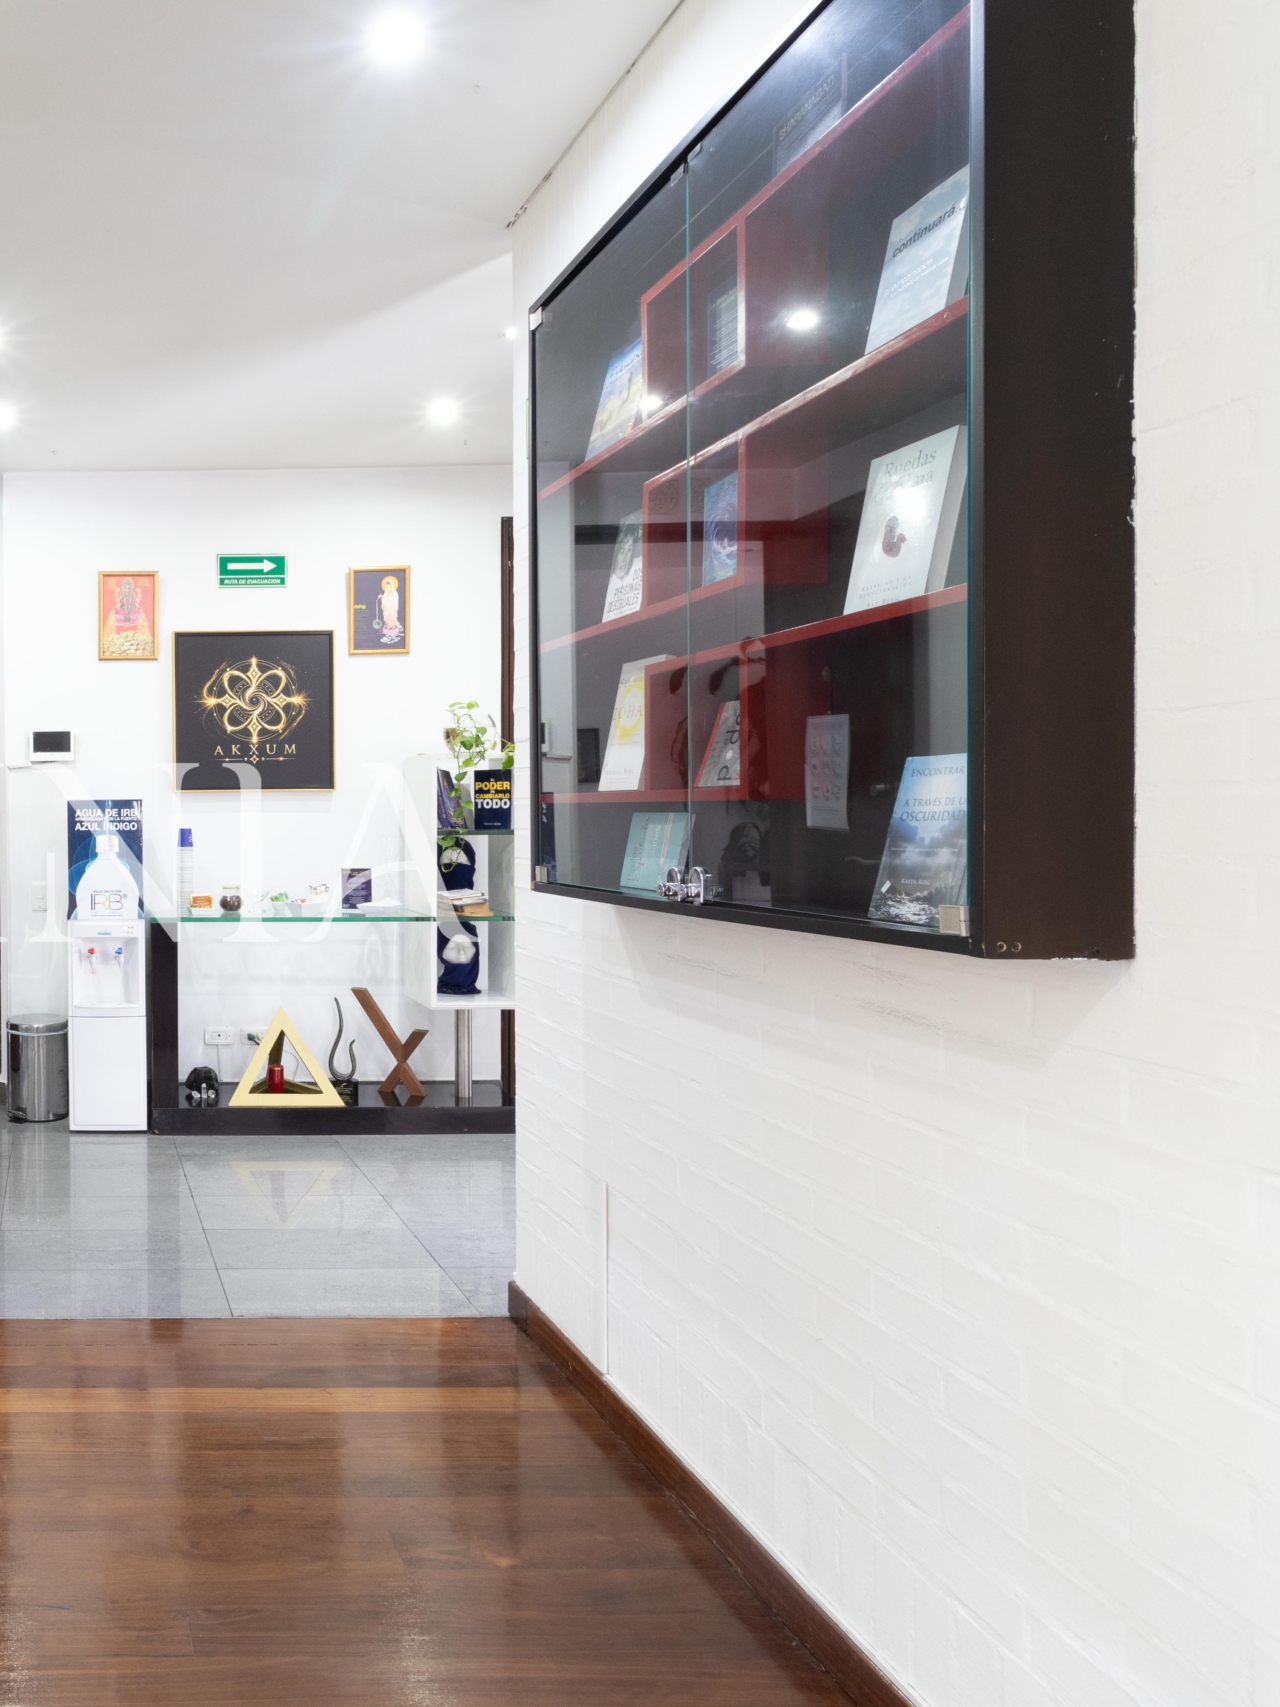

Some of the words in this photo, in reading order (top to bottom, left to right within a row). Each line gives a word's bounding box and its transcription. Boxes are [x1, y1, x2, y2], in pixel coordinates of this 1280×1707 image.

[885, 449, 937, 479] Ruedas
[612, 703, 642, 721] ZÓHA
[214, 743, 296, 755] AKXUM
[911, 765, 965, 778] ENCONTRAR
[475, 781, 511, 791] PODER
[475, 798, 511, 809] TODO
[903, 798, 910, 808] A
[912, 796, 943, 808] TRAVÉS
[944, 796, 957, 807] DE
[75, 808, 103, 817] AGUA
[105, 808, 118, 817] DE
[121, 808, 138, 817] IRB
[900, 810, 966, 822] OSCURIDAD
[75, 822, 101, 831] AZUL
[900, 877, 917, 885] KAREN
[918, 878, 931, 886] BERG
